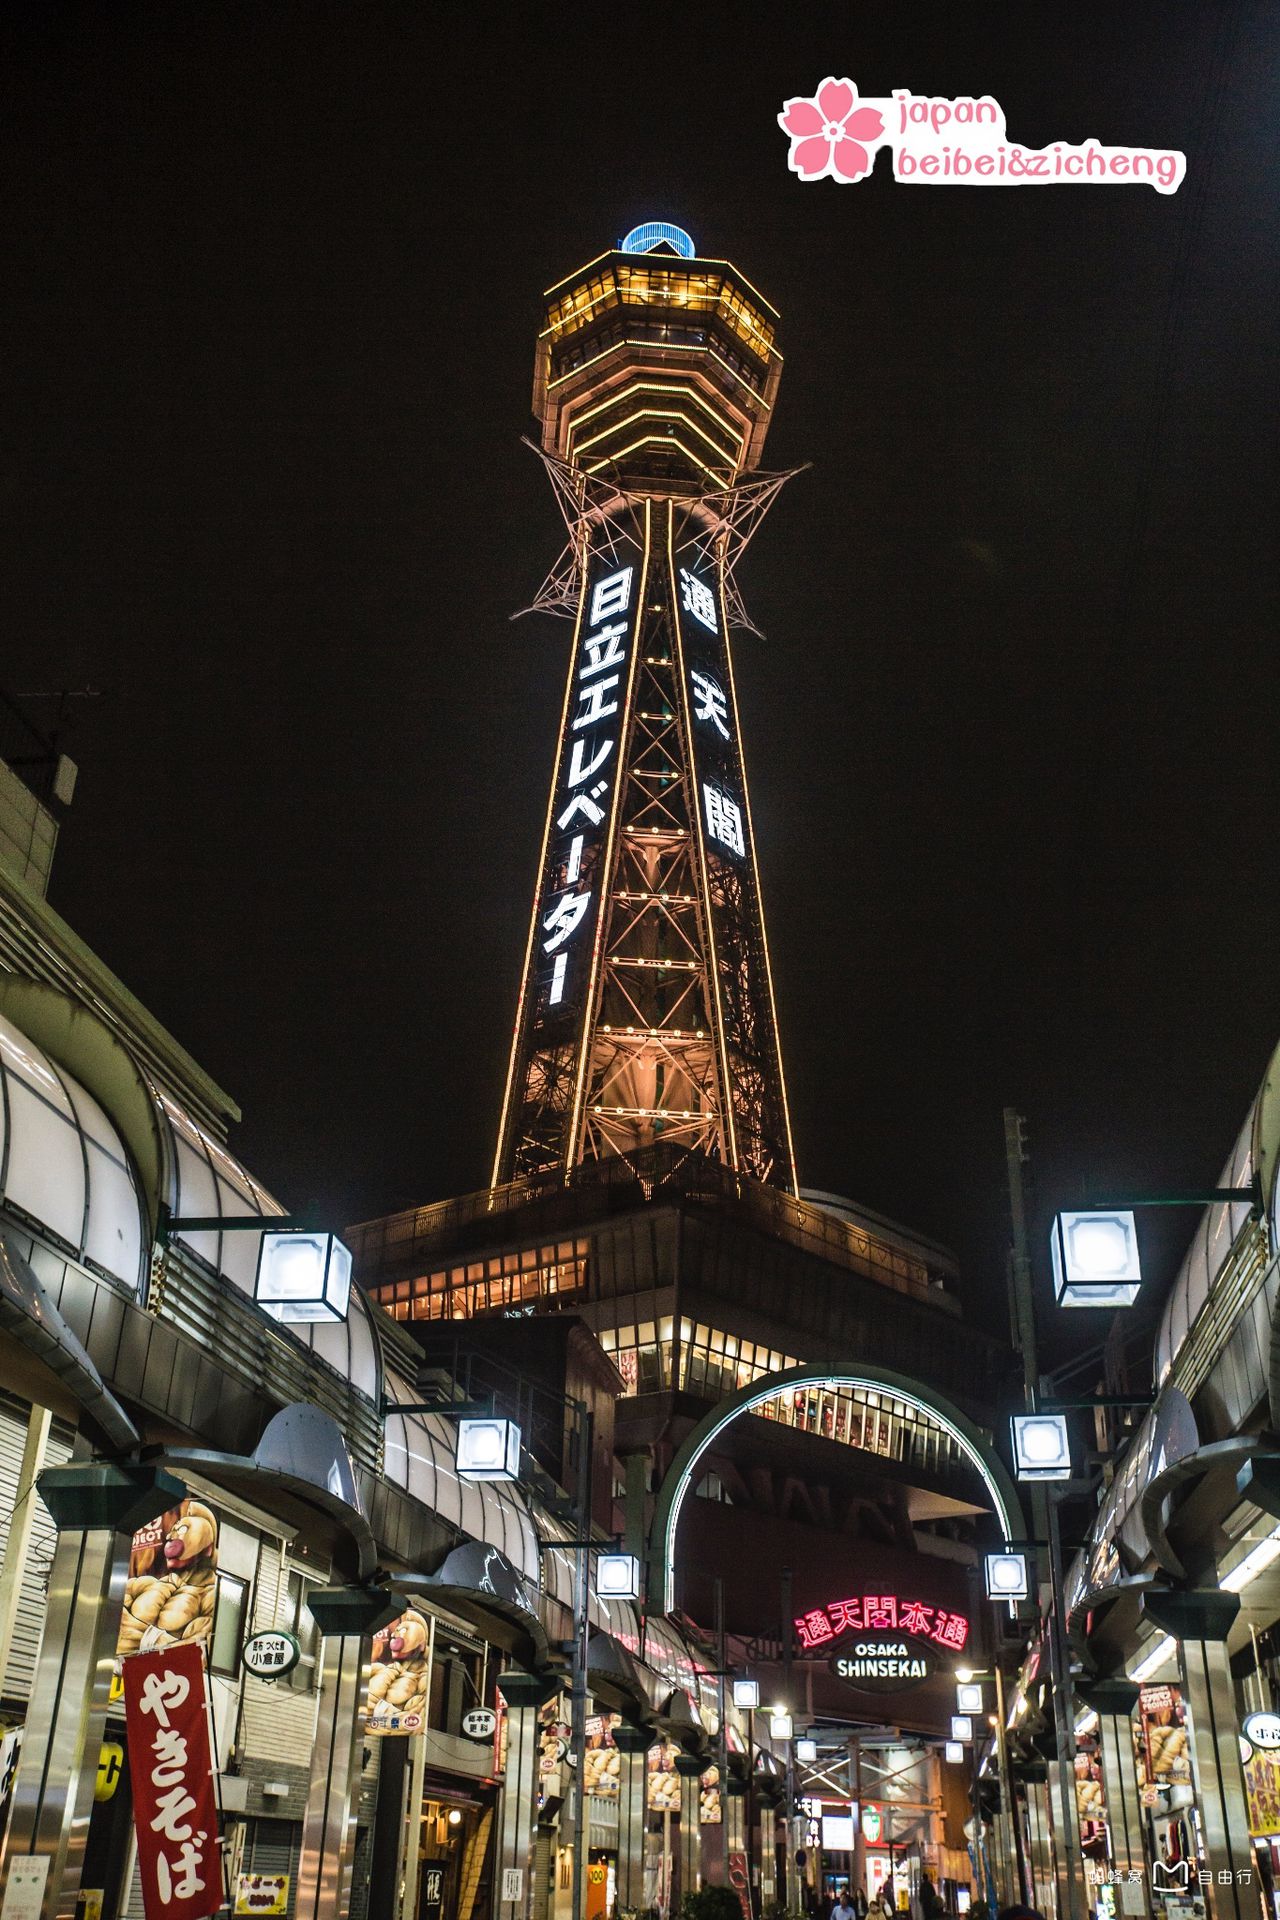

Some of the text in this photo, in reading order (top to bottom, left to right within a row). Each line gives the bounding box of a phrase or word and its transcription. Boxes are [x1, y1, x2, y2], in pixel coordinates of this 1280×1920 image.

[679, 567, 746, 858] 通天閣
[543, 566, 633, 1006] 日立エレベーター
[794, 1596, 969, 1651] 通天閣本通
[855, 1643, 908, 1657] OSAKA
[251, 1652, 285, 1665] 小倉屋
[837, 1659, 927, 1678] SHINSEKAI
[139, 1669, 208, 1905] やきそば
